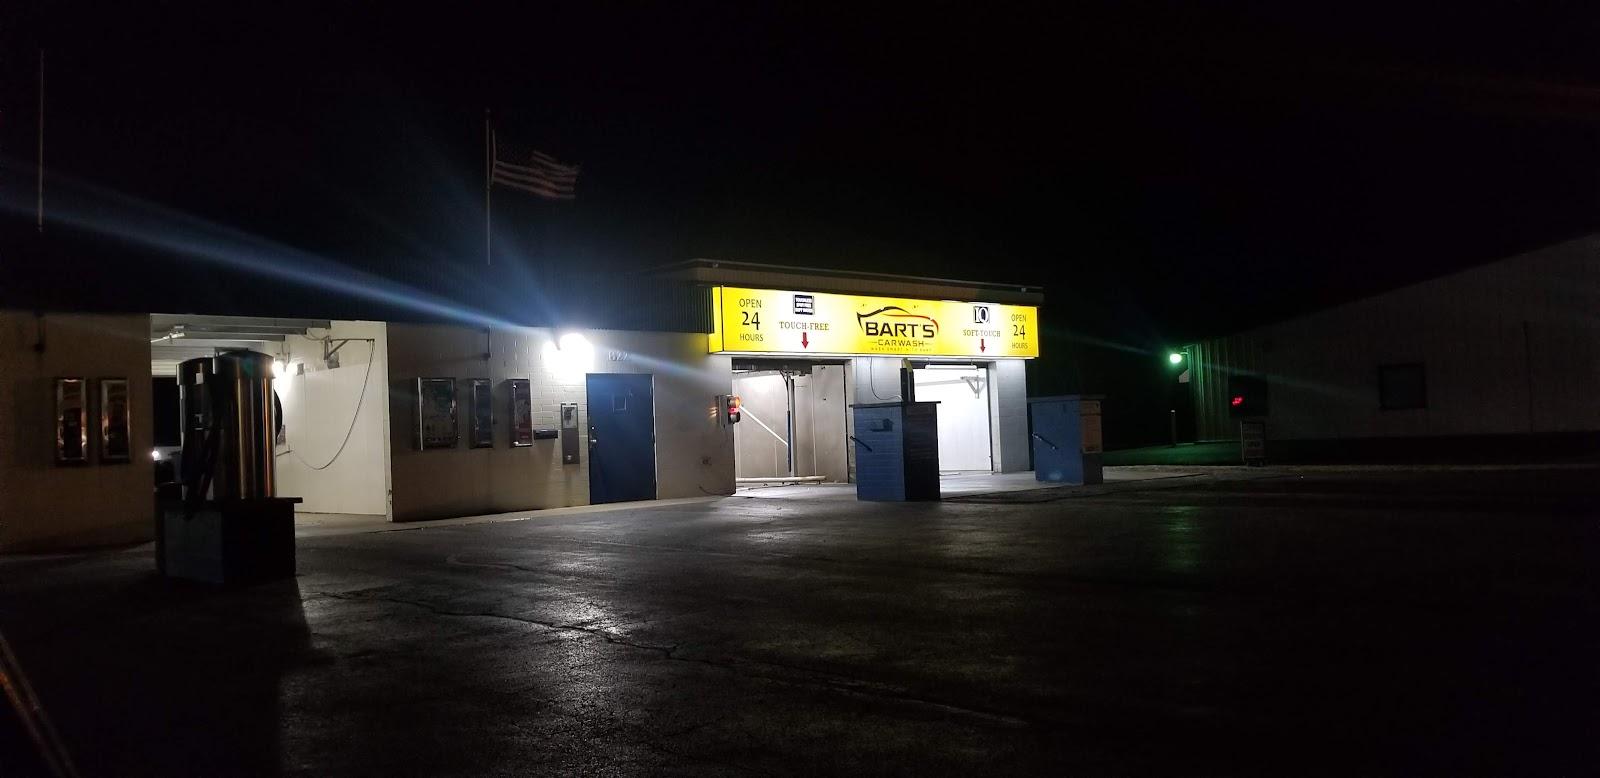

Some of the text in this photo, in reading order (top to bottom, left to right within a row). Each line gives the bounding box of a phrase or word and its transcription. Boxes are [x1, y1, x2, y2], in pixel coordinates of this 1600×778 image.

[738, 298, 762, 308] OPEN
[741, 311, 761, 330] 24
[1011, 313, 1027, 322] OPEN
[779, 321, 830, 331] TOUCH-FREE
[865, 321, 935, 338] BART'S
[1013, 324, 1026, 340] 24
[739, 333, 764, 342] HOURS
[877, 339, 924, 347] CARWASH
[1011, 342, 1029, 350] HOURS
